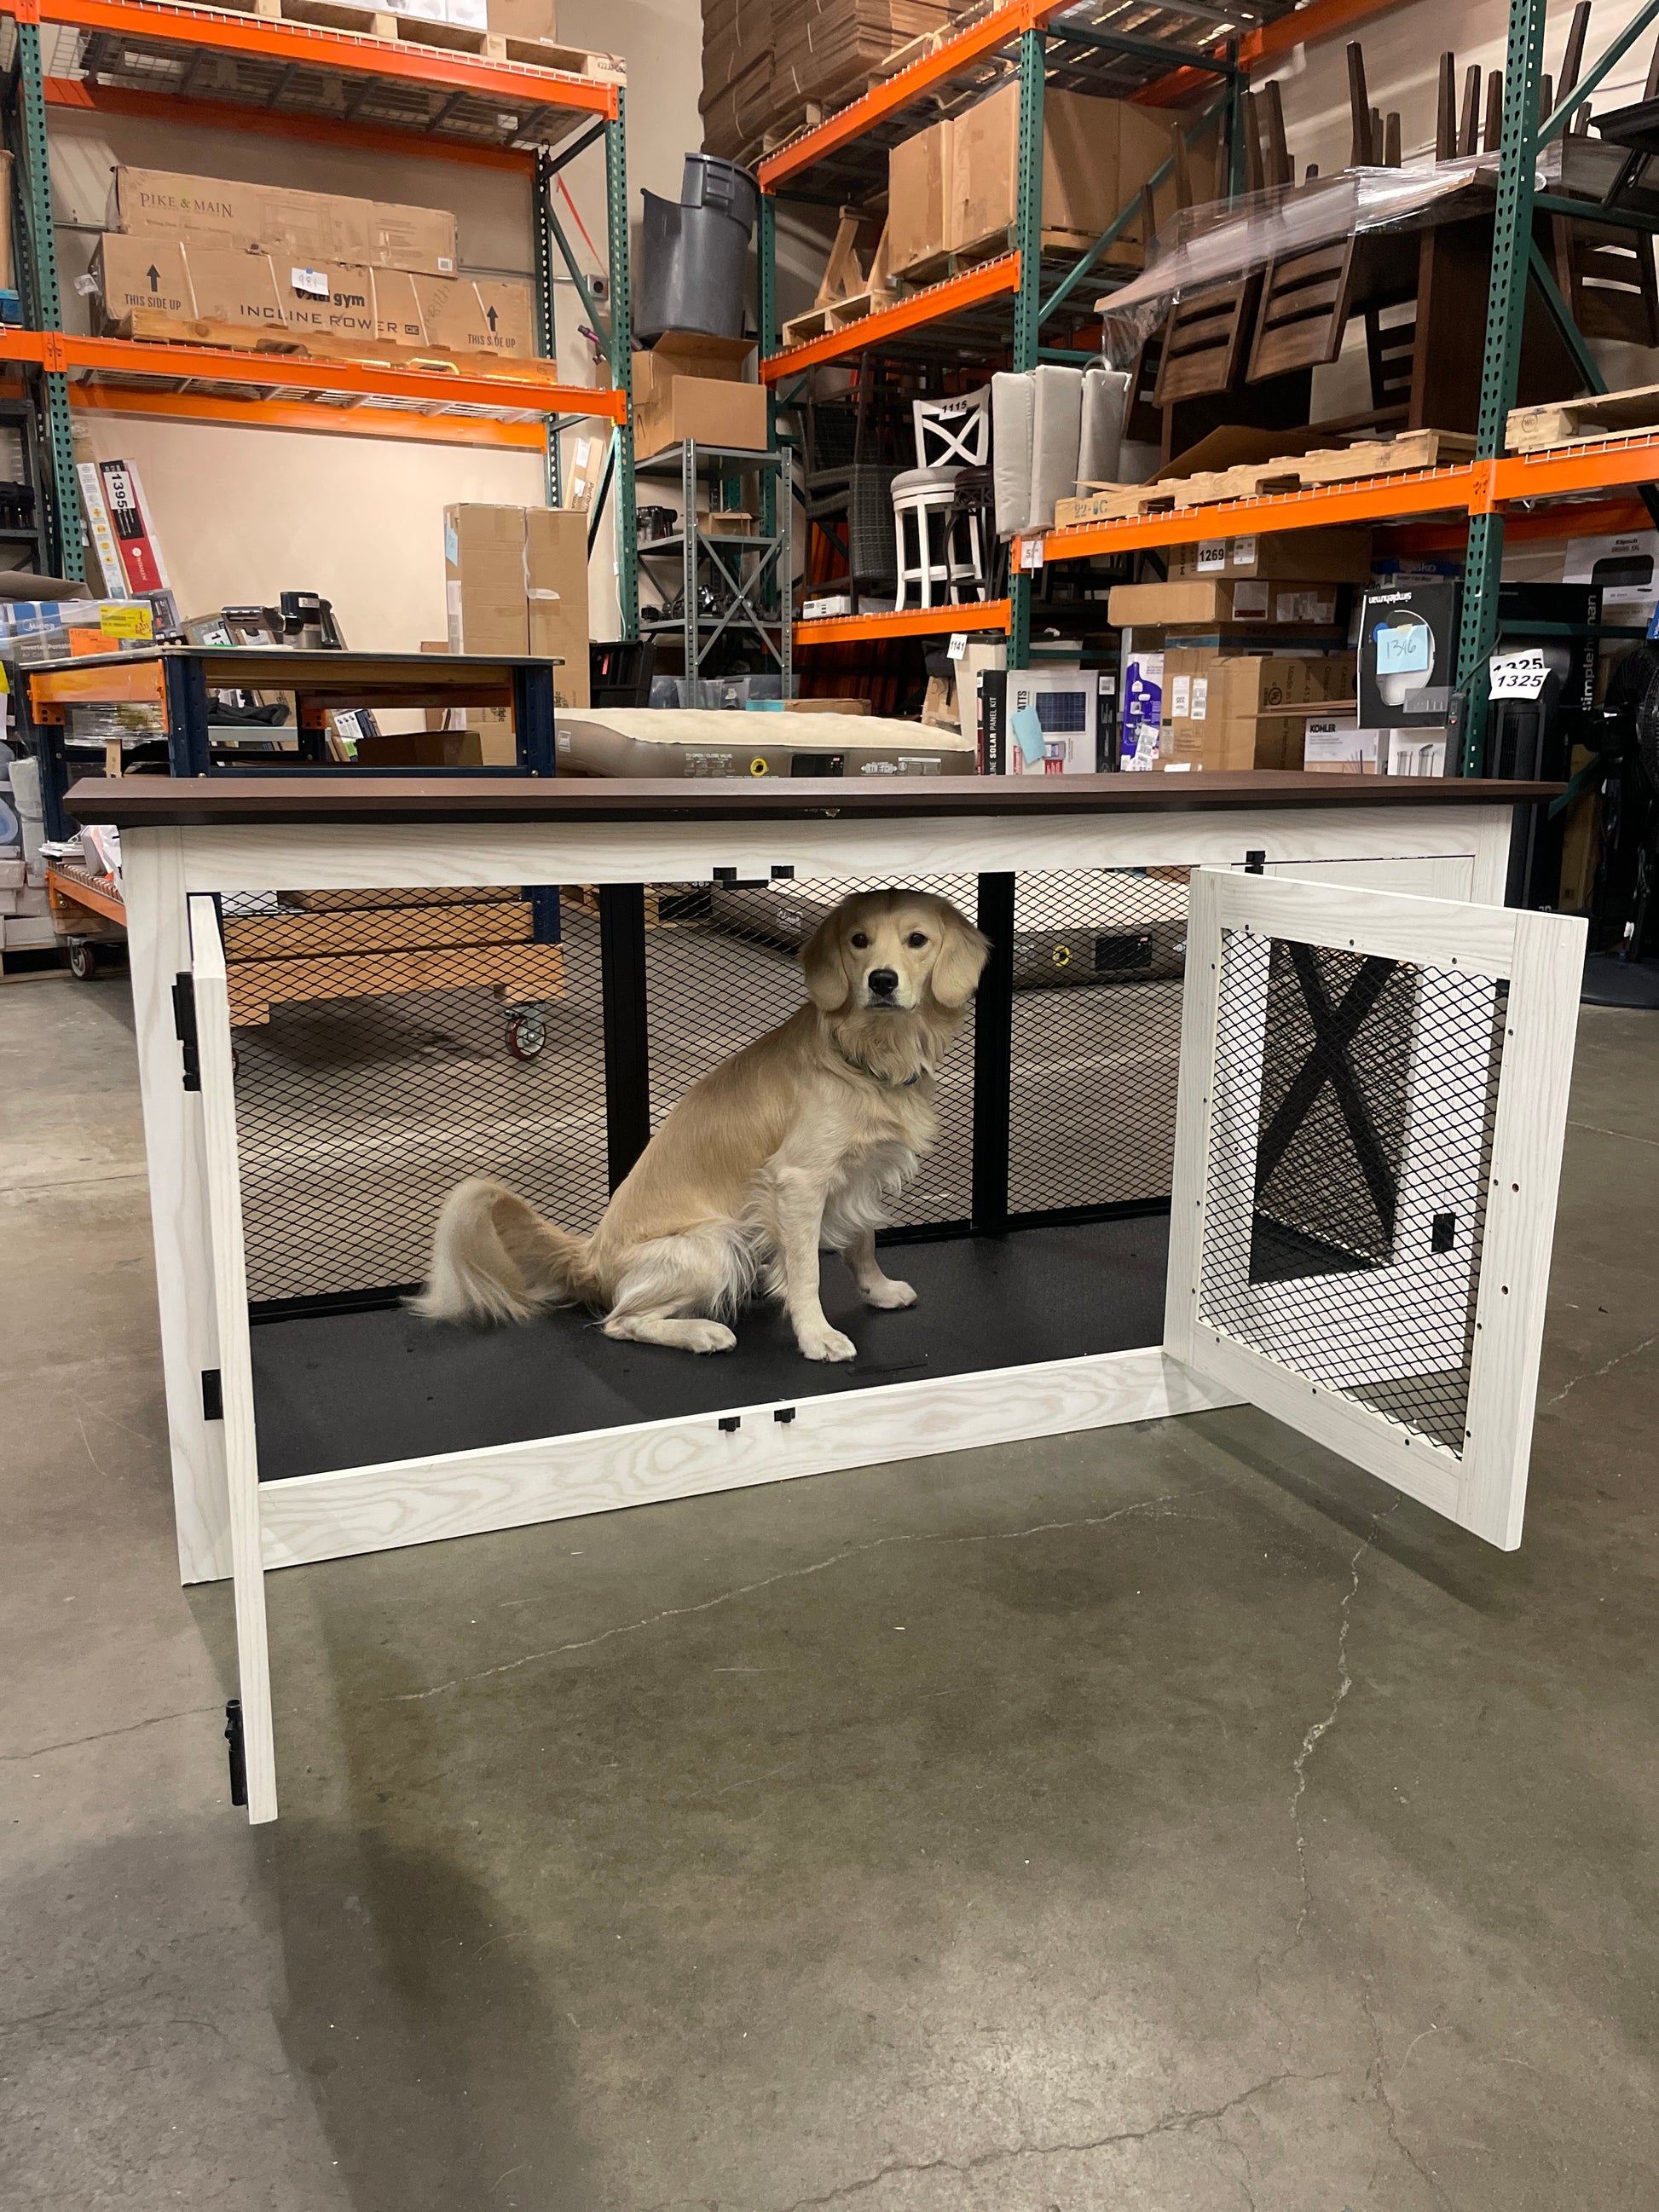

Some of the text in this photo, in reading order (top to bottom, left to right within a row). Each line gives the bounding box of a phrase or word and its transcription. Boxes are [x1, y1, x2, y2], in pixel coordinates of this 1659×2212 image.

[140, 193, 176, 207] PIKE
[180, 198, 190, 209] &
[194, 199, 234, 218] MAIN
[298, 274, 317, 287] 981
[124, 293, 182, 310] THIS SIDE UP
[333, 293, 365, 308] gym
[240, 304, 322, 325] INCLINE
[329, 315, 397, 333] ROWER
[467, 333, 485, 346] THIS
[505, 338, 516, 349] UP
[942, 400, 968, 413] 1115
[112, 473, 128, 509] 1395
[1199, 548, 1224, 562] 1269
[1368, 591, 1413, 604] simplehuman
[950, 640, 965, 652] 1141
[1581, 595, 1597, 711] simplehman
[1497, 674, 1544, 688] 1325
[1017, 690, 1027, 712] ATTS
[1309, 724, 1336, 733] KOHLER
